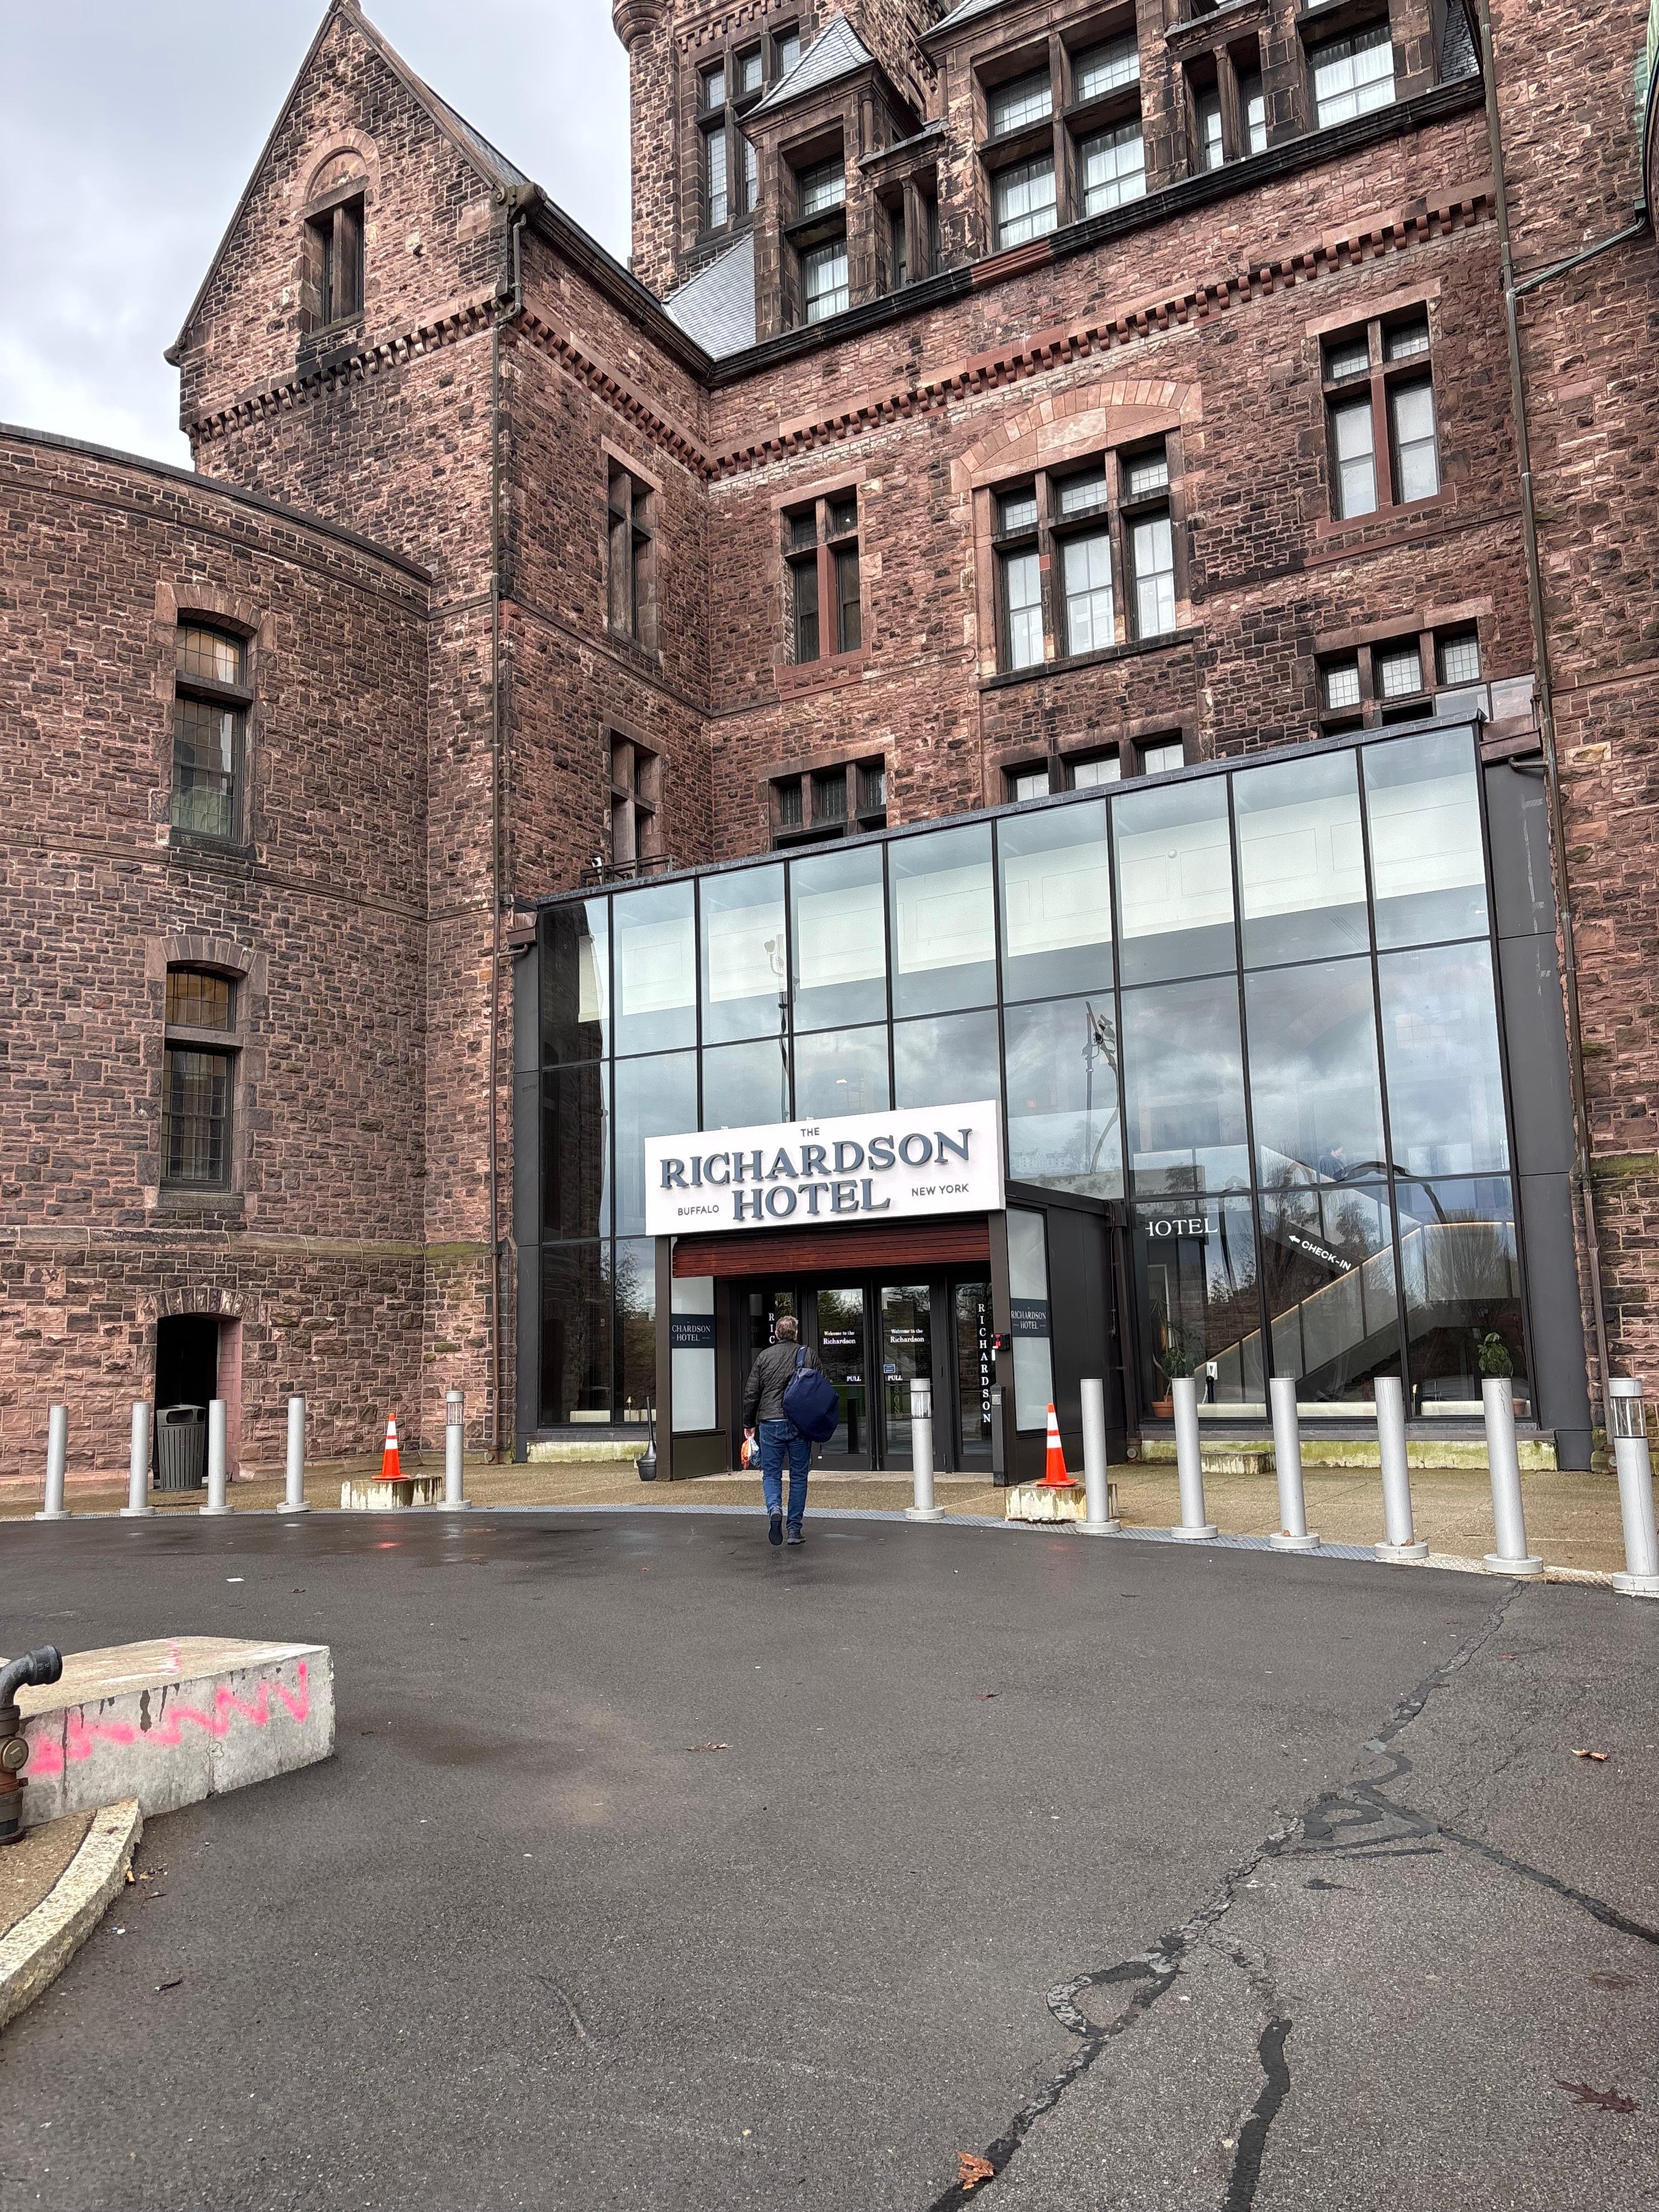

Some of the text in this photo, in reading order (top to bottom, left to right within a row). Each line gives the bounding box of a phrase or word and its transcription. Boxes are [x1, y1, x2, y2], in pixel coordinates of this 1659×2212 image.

[800, 1127, 820, 1137] THE
[659, 1128, 973, 1189] RICHARDSON
[911, 1183, 969, 1197] NEW YORK
[732, 1178, 891, 1222] HOTEL
[677, 1205, 720, 1216] BUFFALO
[1301, 1240, 1352, 1271] CHECK-IN
[1011, 1310, 1046, 1320] RICHARDSON
[672, 1324, 711, 1333] CHARDSON
[1020, 1321, 1039, 1329] HOTEL
[676, 1333, 700, 1341] HOTEL
[978, 1303, 991, 1423] RICHARDSON
